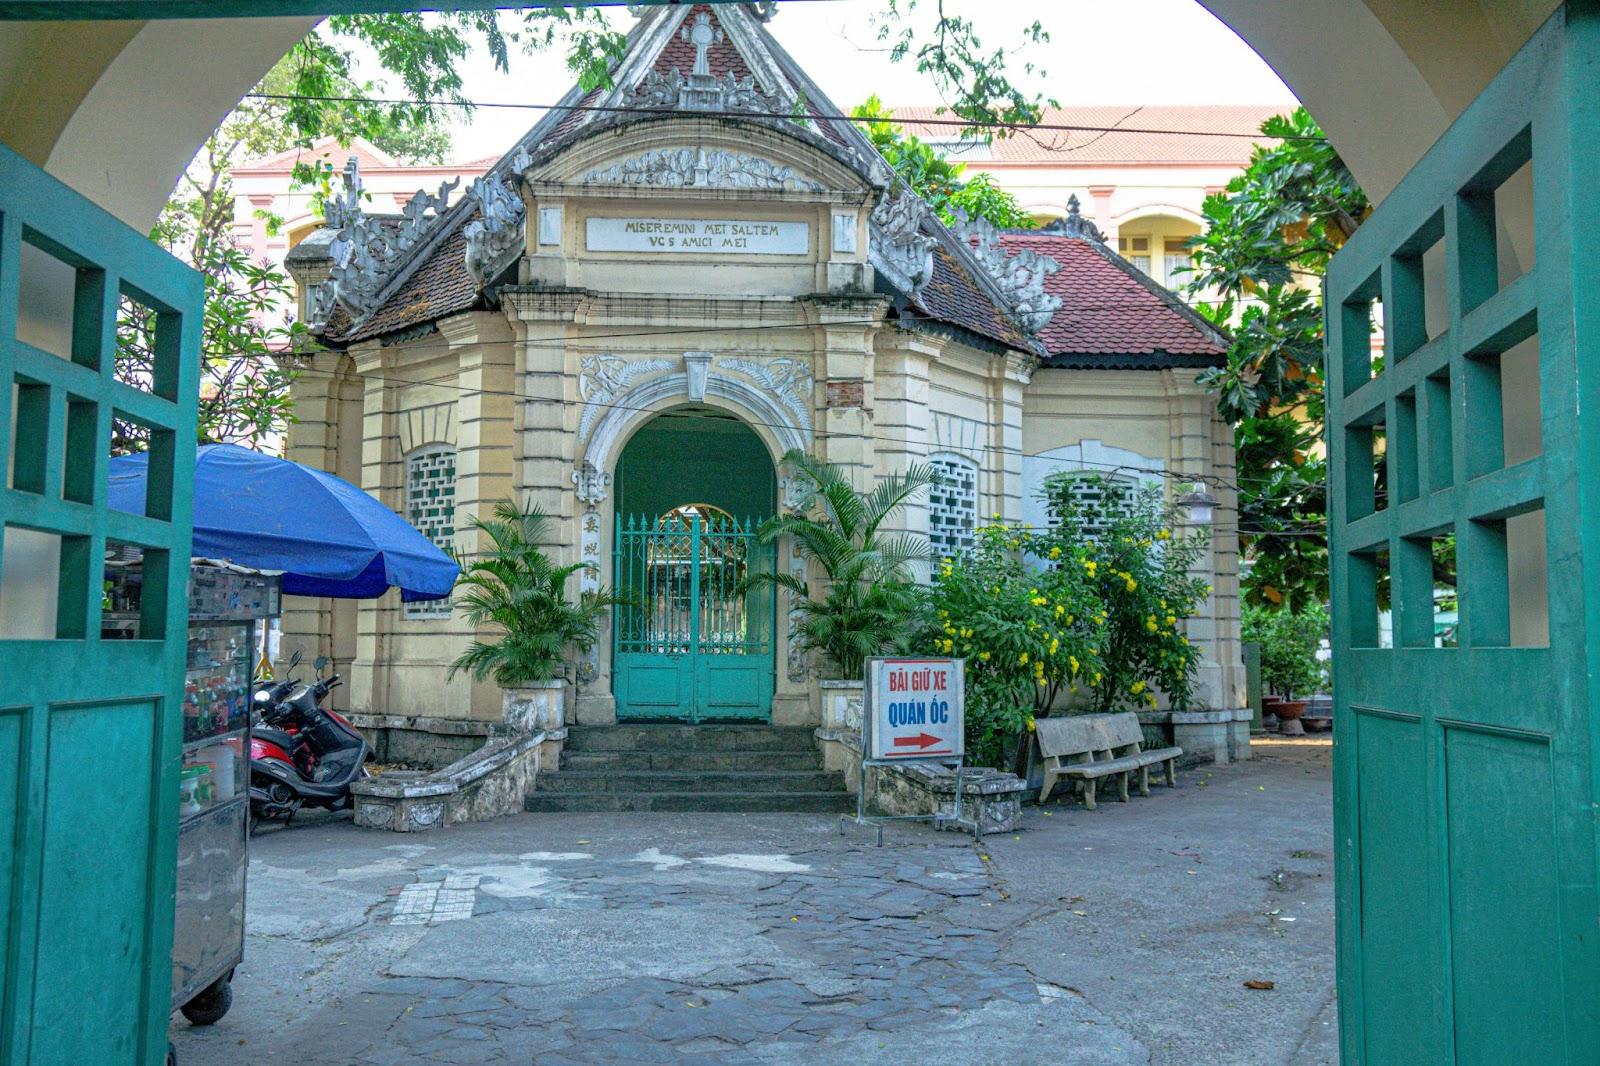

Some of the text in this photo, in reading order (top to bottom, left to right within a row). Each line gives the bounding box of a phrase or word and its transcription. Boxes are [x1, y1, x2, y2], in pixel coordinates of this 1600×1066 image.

[625, 222, 779, 236] MISEREMINI MEI SALTEM
[681, 237, 713, 247] AMICI
[721, 238, 747, 248] MEI
[890, 667, 947, 691] BÃI GIỮ XE
[888, 694, 948, 728] QUÁN ỐC
